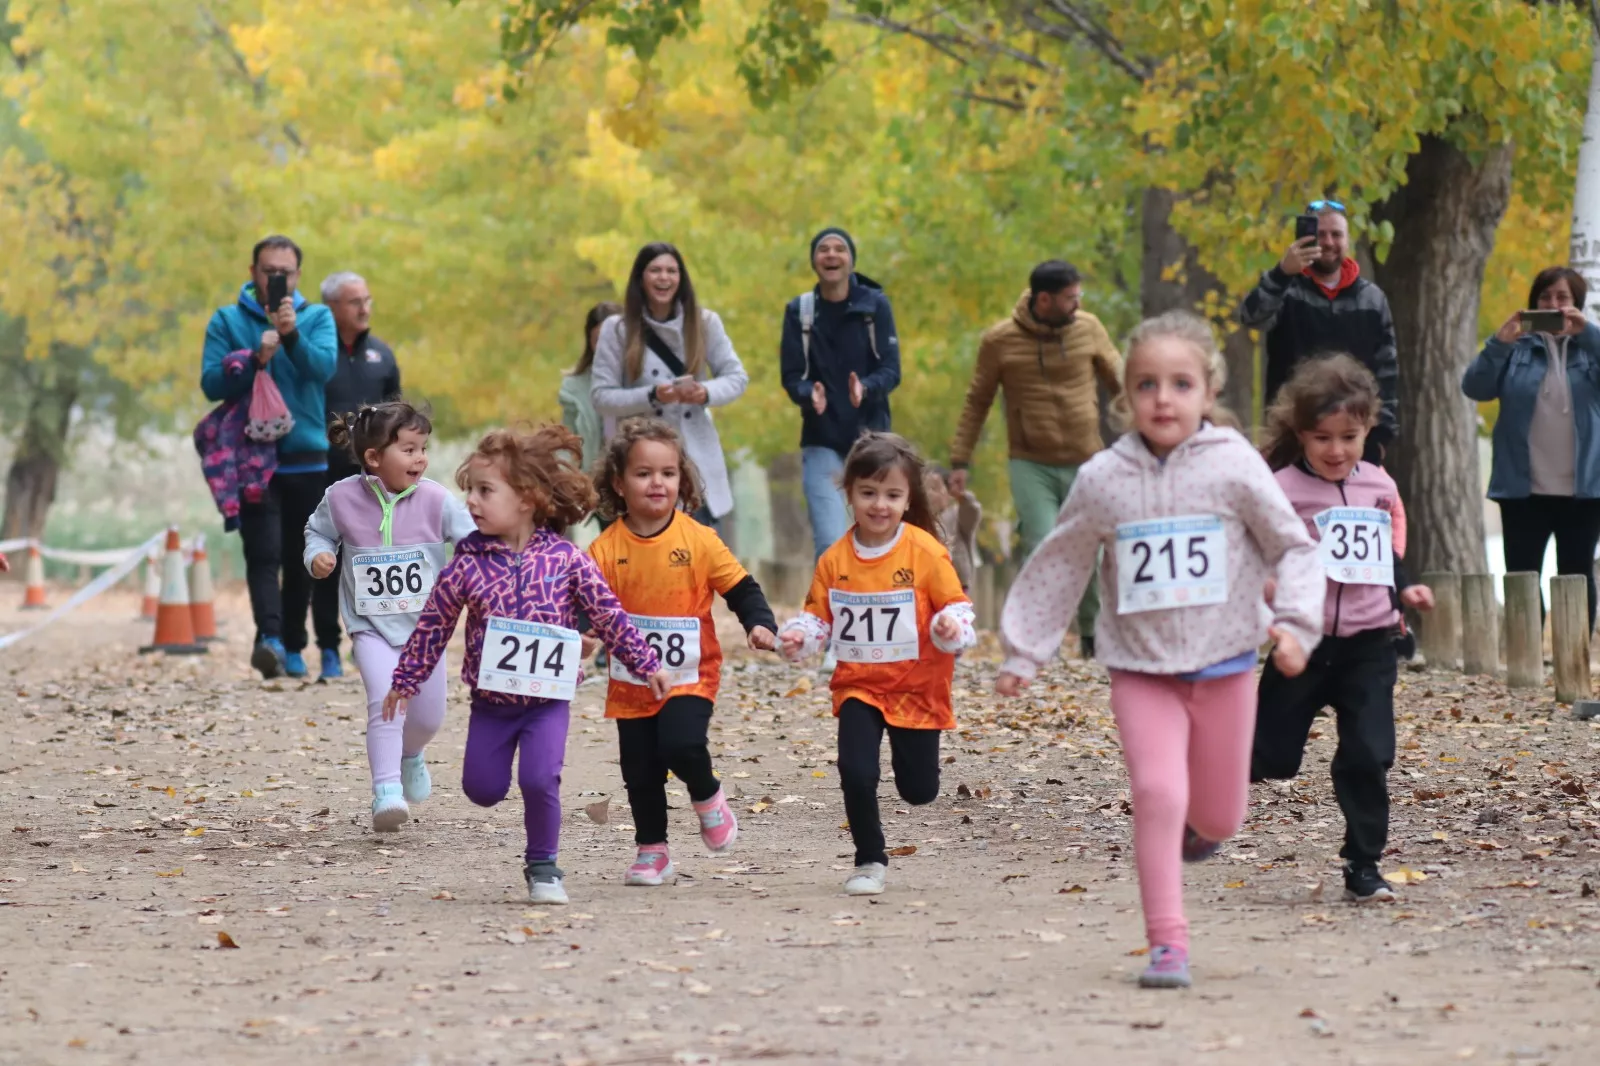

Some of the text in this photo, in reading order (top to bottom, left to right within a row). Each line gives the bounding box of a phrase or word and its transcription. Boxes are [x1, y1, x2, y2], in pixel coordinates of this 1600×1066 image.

[354, 556, 371, 564] CROSS
[397, 551, 423, 560] MEQUINE
[1132, 535, 1209, 585] 215
[1331, 523, 1381, 562] 351
[366, 562, 422, 596] 366
[839, 606, 901, 642] 217
[496, 635, 564, 677] 214
[644, 631, 685, 668] 68
